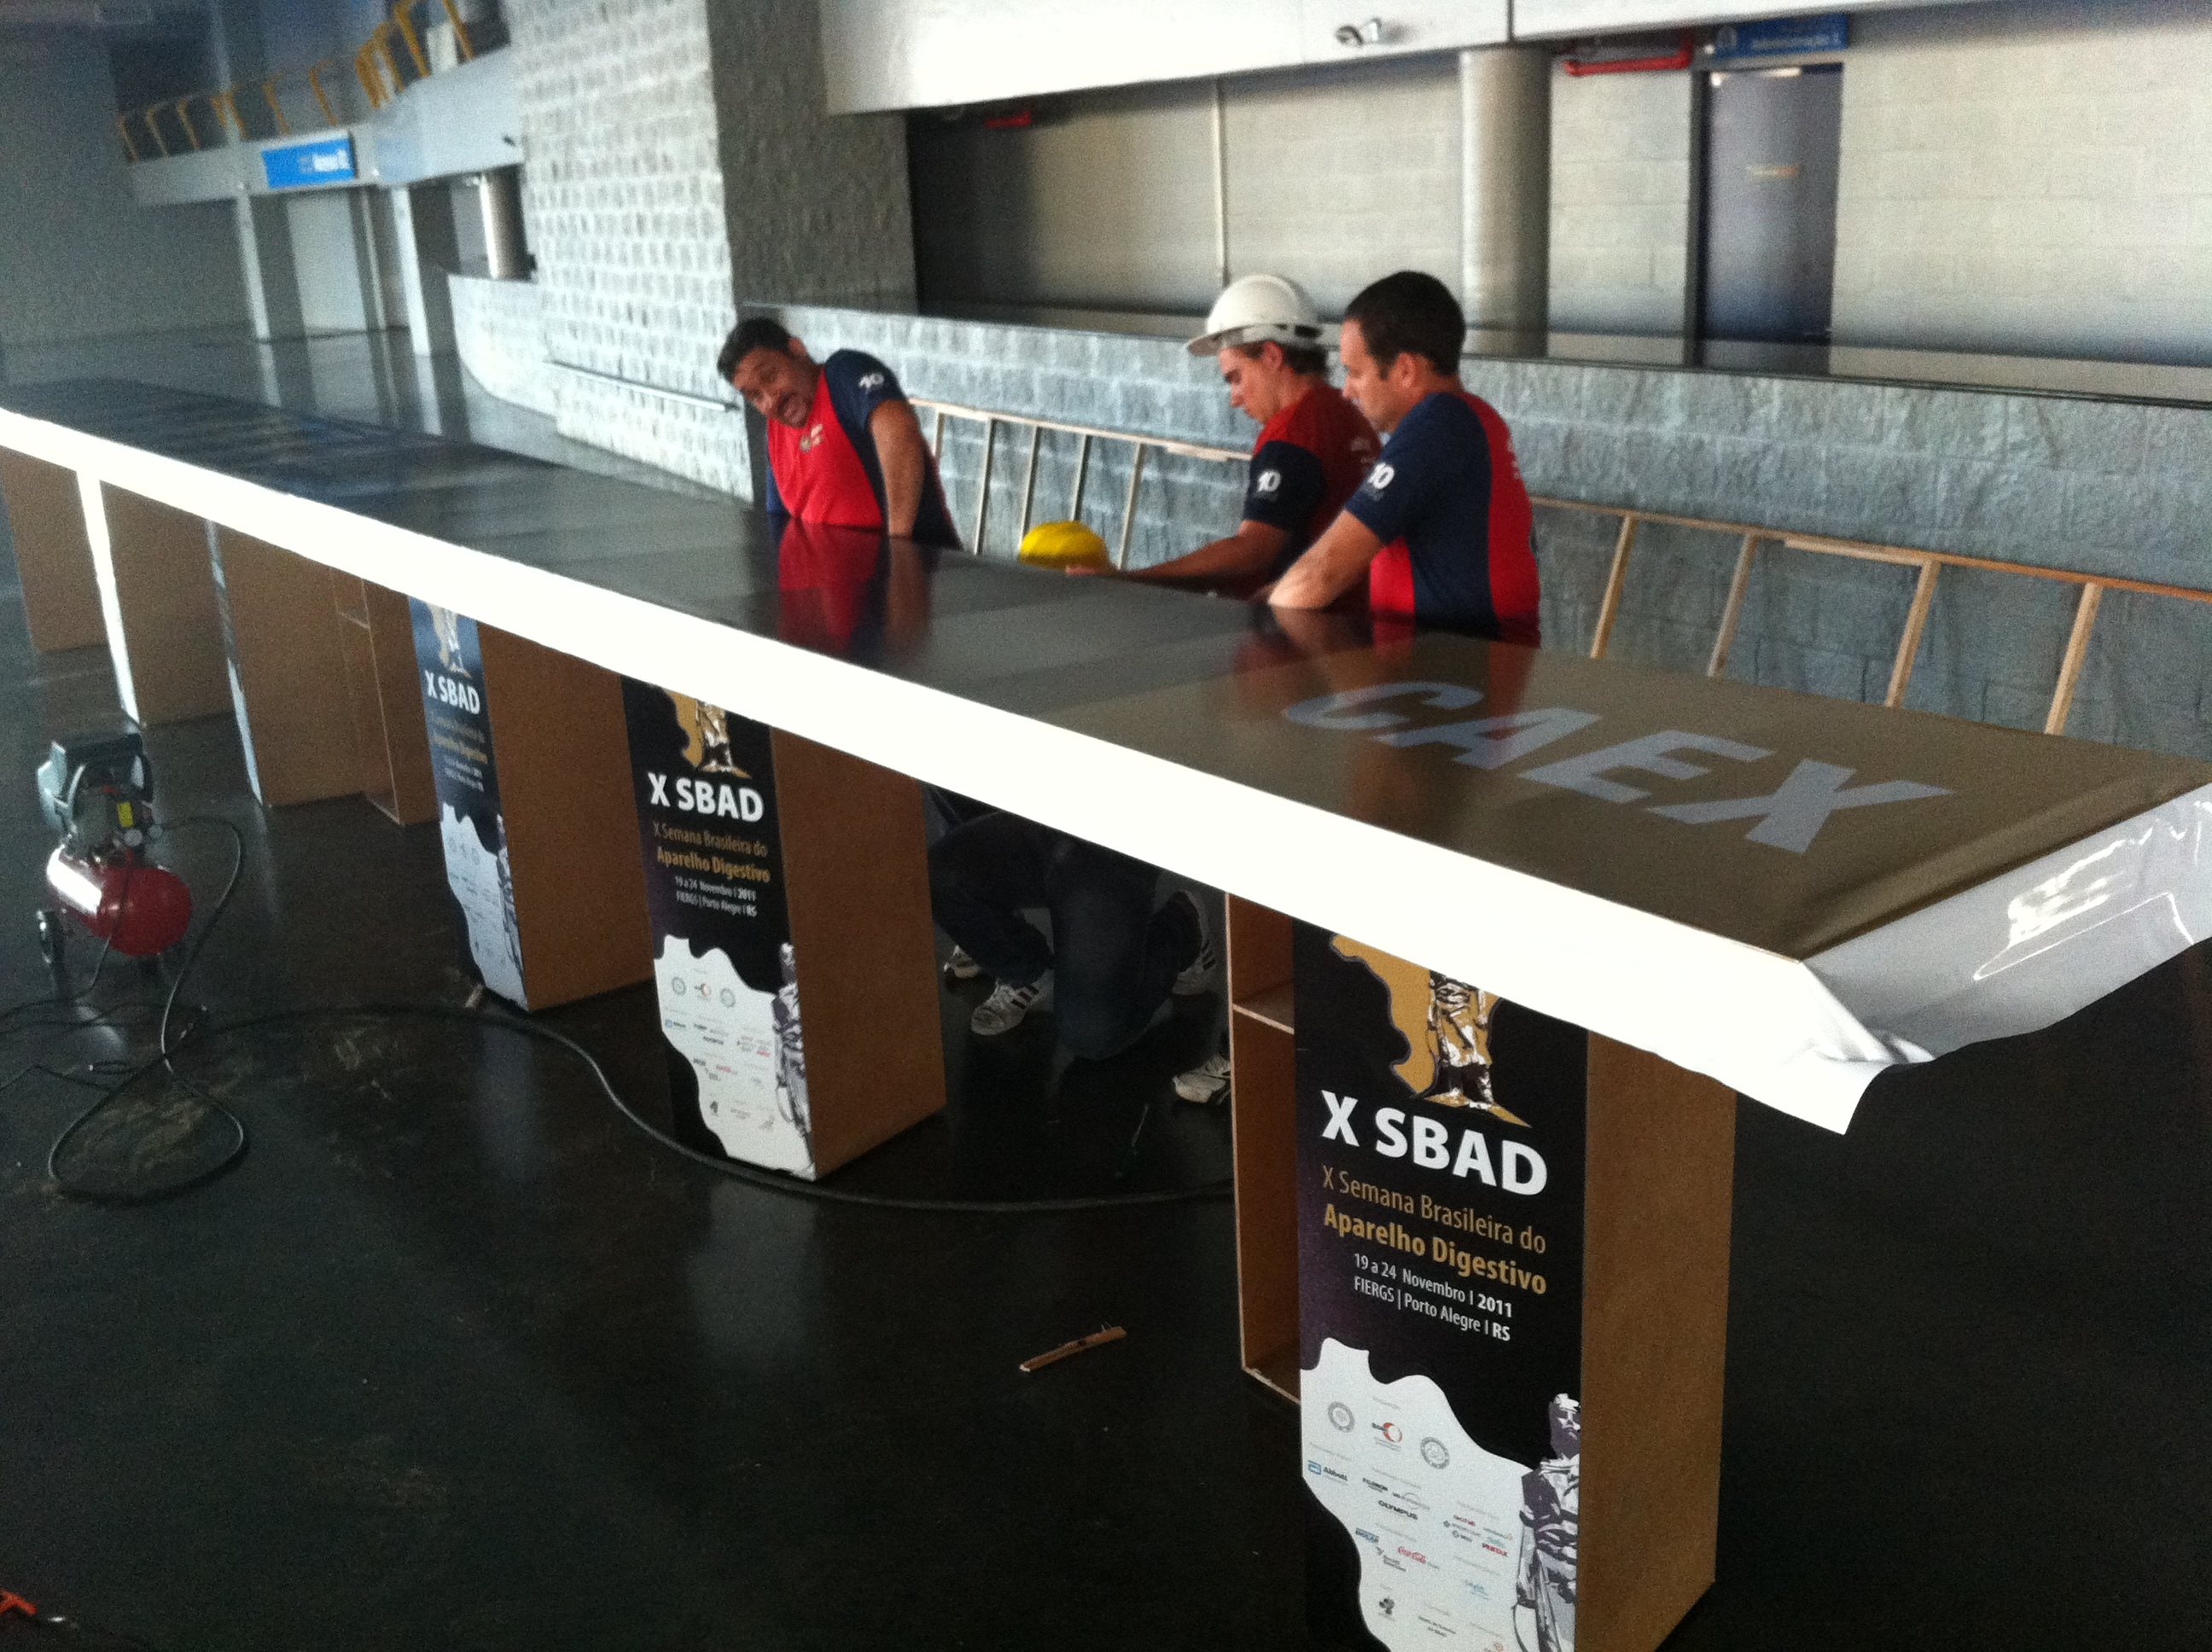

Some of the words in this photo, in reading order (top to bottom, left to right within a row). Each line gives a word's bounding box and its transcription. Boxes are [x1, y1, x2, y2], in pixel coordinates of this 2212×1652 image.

[1258, 470, 1281, 492] 10
[425, 670, 438, 699] X
[439, 675, 480, 714] SBAD
[648, 771, 671, 807] X
[676, 777, 764, 822] SBAD
[1283, 682, 1956, 853] CAEX
[653, 821, 661, 837] X
[661, 823, 702, 846] Semana
[657, 846, 710, 872] Aparelho
[712, 857, 771, 883] Digestivo
[1321, 1090, 1360, 1147] X
[1375, 1108, 1548, 1195] SBAD
[1323, 1165, 1335, 1190] X
[1339, 1171, 1414, 1215] Semana
[1421, 1195, 1513, 1245] Brasileira
[1520, 1225, 1546, 1254] do
[1324, 1203, 1426, 1256] Aparelho
[1433, 1236, 1547, 1294] Digestivo
[1354, 1253, 1369, 1271] 19
[1371, 1261, 1378, 1274] a
[1382, 1262, 1397, 1280] 24
[1402, 1268, 1465, 1303] Novembro
[1477, 1293, 1512, 1318] 2011
[1354, 1276, 1394, 1302] FIERGS
[1405, 1293, 1438, 1318] Porto
[1440, 1306, 1481, 1334] Alegre
[1493, 1322, 1511, 1341] RS
[1378, 1499, 1418, 1520] OLYMPUS
